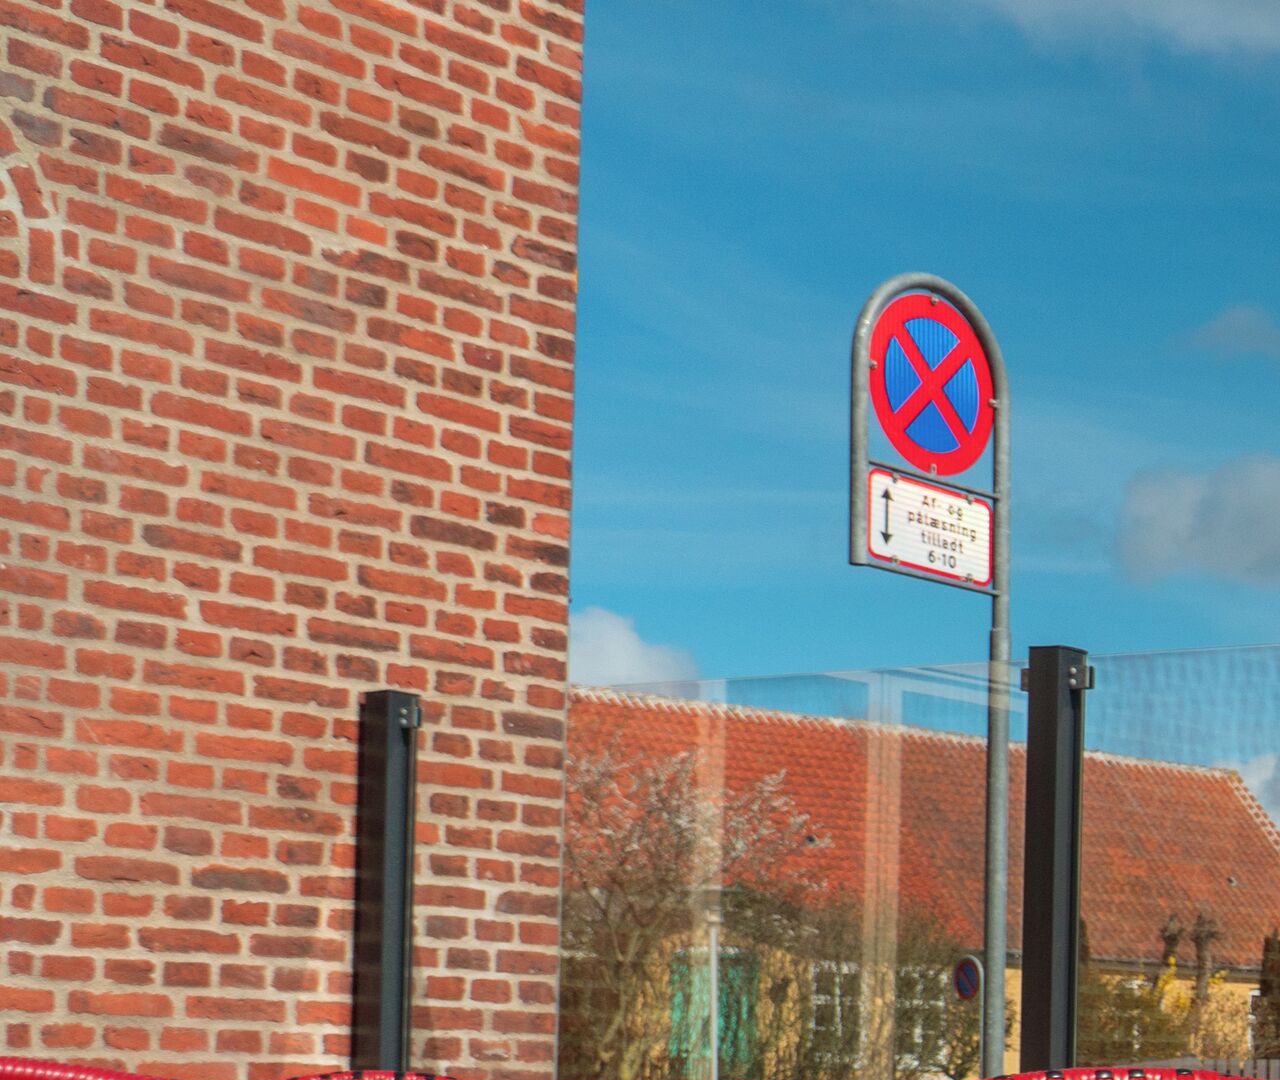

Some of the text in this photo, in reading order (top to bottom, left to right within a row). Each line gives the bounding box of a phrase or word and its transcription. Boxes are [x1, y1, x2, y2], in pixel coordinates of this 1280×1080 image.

[948, 505, 963, 521] og
[908, 511, 977, 542] pålæsning
[921, 532, 964, 553] tilladt
[928, 550, 957, 568] 6-10
